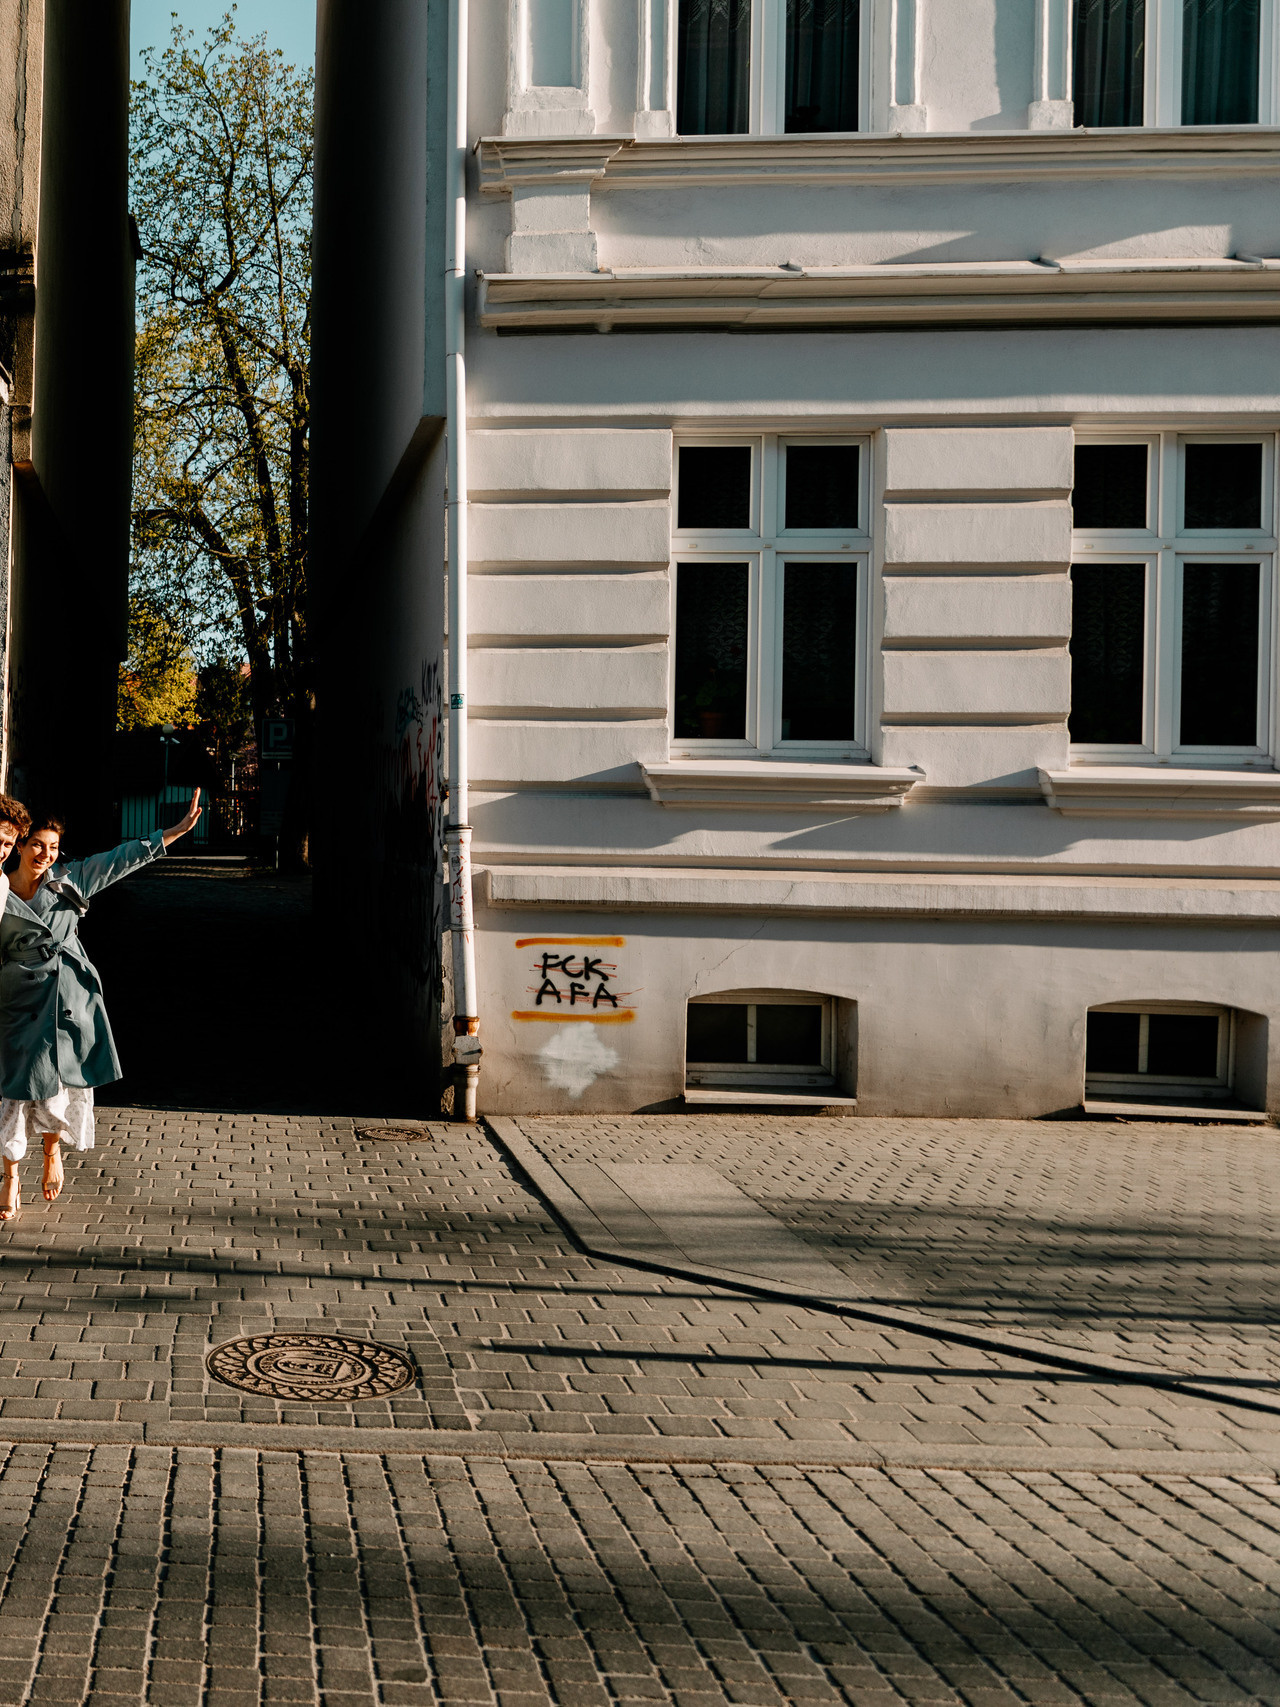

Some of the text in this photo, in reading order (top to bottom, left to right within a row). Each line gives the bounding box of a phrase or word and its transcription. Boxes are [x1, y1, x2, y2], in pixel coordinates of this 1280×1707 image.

[268, 722, 288, 748] P
[541, 952, 609, 981] FCK
[535, 978, 618, 1008] AFA
